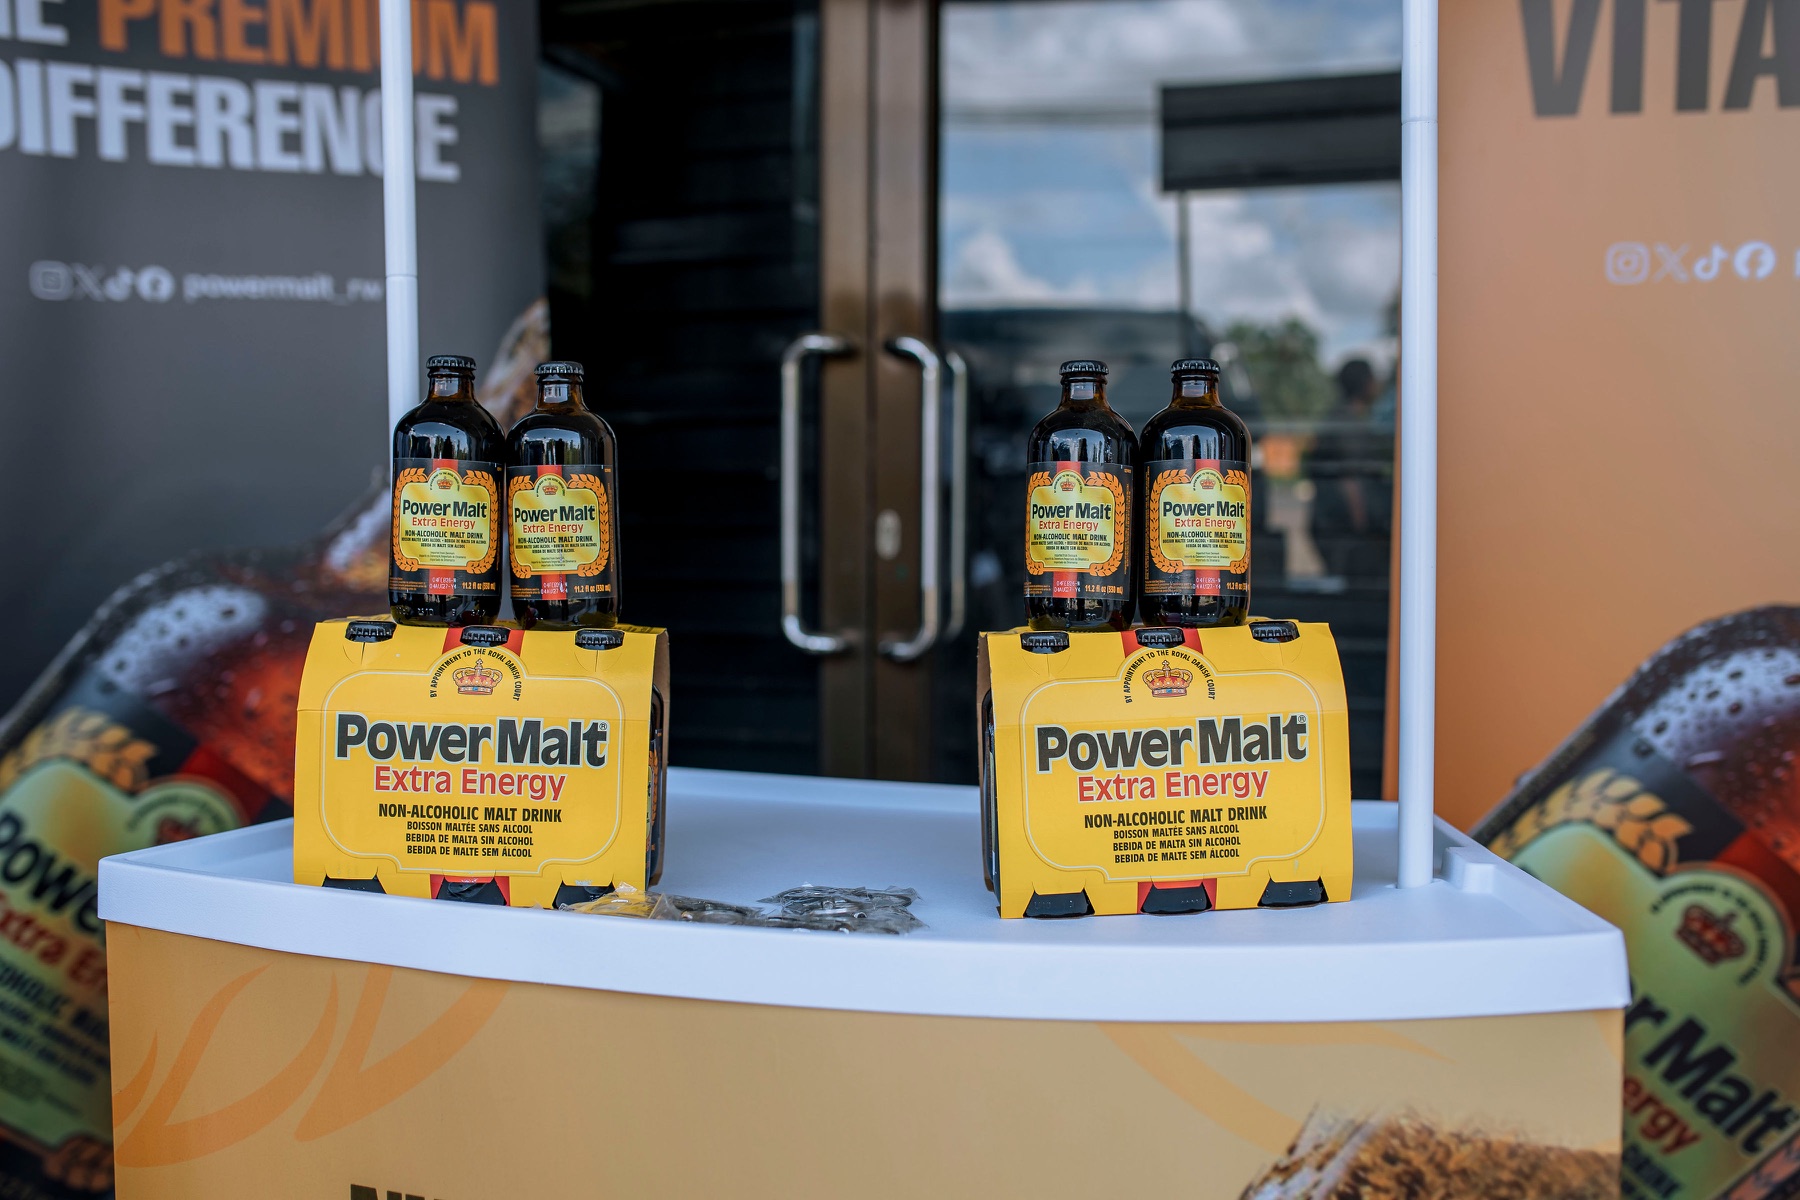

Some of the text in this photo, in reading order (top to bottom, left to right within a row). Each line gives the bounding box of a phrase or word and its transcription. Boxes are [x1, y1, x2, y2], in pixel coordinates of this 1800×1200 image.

[402, 499, 451, 516] Power
[514, 507, 558, 523] Power
[1032, 503, 1074, 519] Power
[1162, 501, 1215, 517] Power
[412, 517, 476, 530] Extra Energy
[522, 523, 584, 534] Extra Energy
[1038, 520, 1099, 531] Extra Energy
[1174, 517, 1237, 530] Extra Energy
[404, 529, 484, 540] NON-ALCOHOLIC MALT DRINK
[517, 536, 557, 544] NON-ALCOHOLIC
[575, 535, 593, 543] DRINK
[1072, 533, 1088, 541] MALT
[1213, 531, 1228, 539] MALT
[1085, 584, 1095, 592] 11.2
[487, 650, 507, 662] ROYAL
[431, 653, 462, 689] APPOINTMENT
[505, 659, 521, 680] DANISH
[1123, 649, 1216, 704] BY APPOINTMENT TO THE ROYAL DANISH COURT
[430, 689, 437, 698] BY
[513, 681, 522, 701] COURT
[336, 712, 493, 764] Power
[1036, 725, 1193, 773] Power
[374, 765, 567, 802] Extra Energy
[1078, 770, 1269, 802] Extra Energy
[378, 803, 562, 822] NON-ALCOHOLIC MALT DRINK
[1084, 805, 1267, 829] NON-ALCOHOLIC MALT DRINK
[407, 821, 533, 834] BOISSON MALTÉE SANS ALCOOL
[1113, 824, 1239, 839] BOISSON MALTÉE SANS ALCOOL
[405, 833, 534, 846] BEBIDA DE MALTA SIN ALCOHOL
[1113, 836, 1241, 851] BEBIDA DE MALTA SIN ALCOHOL
[407, 845, 532, 857] BEBIDA DE MALTE SEM ÁLCOOL
[1115, 847, 1239, 863] BEBIDA DE MALTE SEM ÁLCOOL
